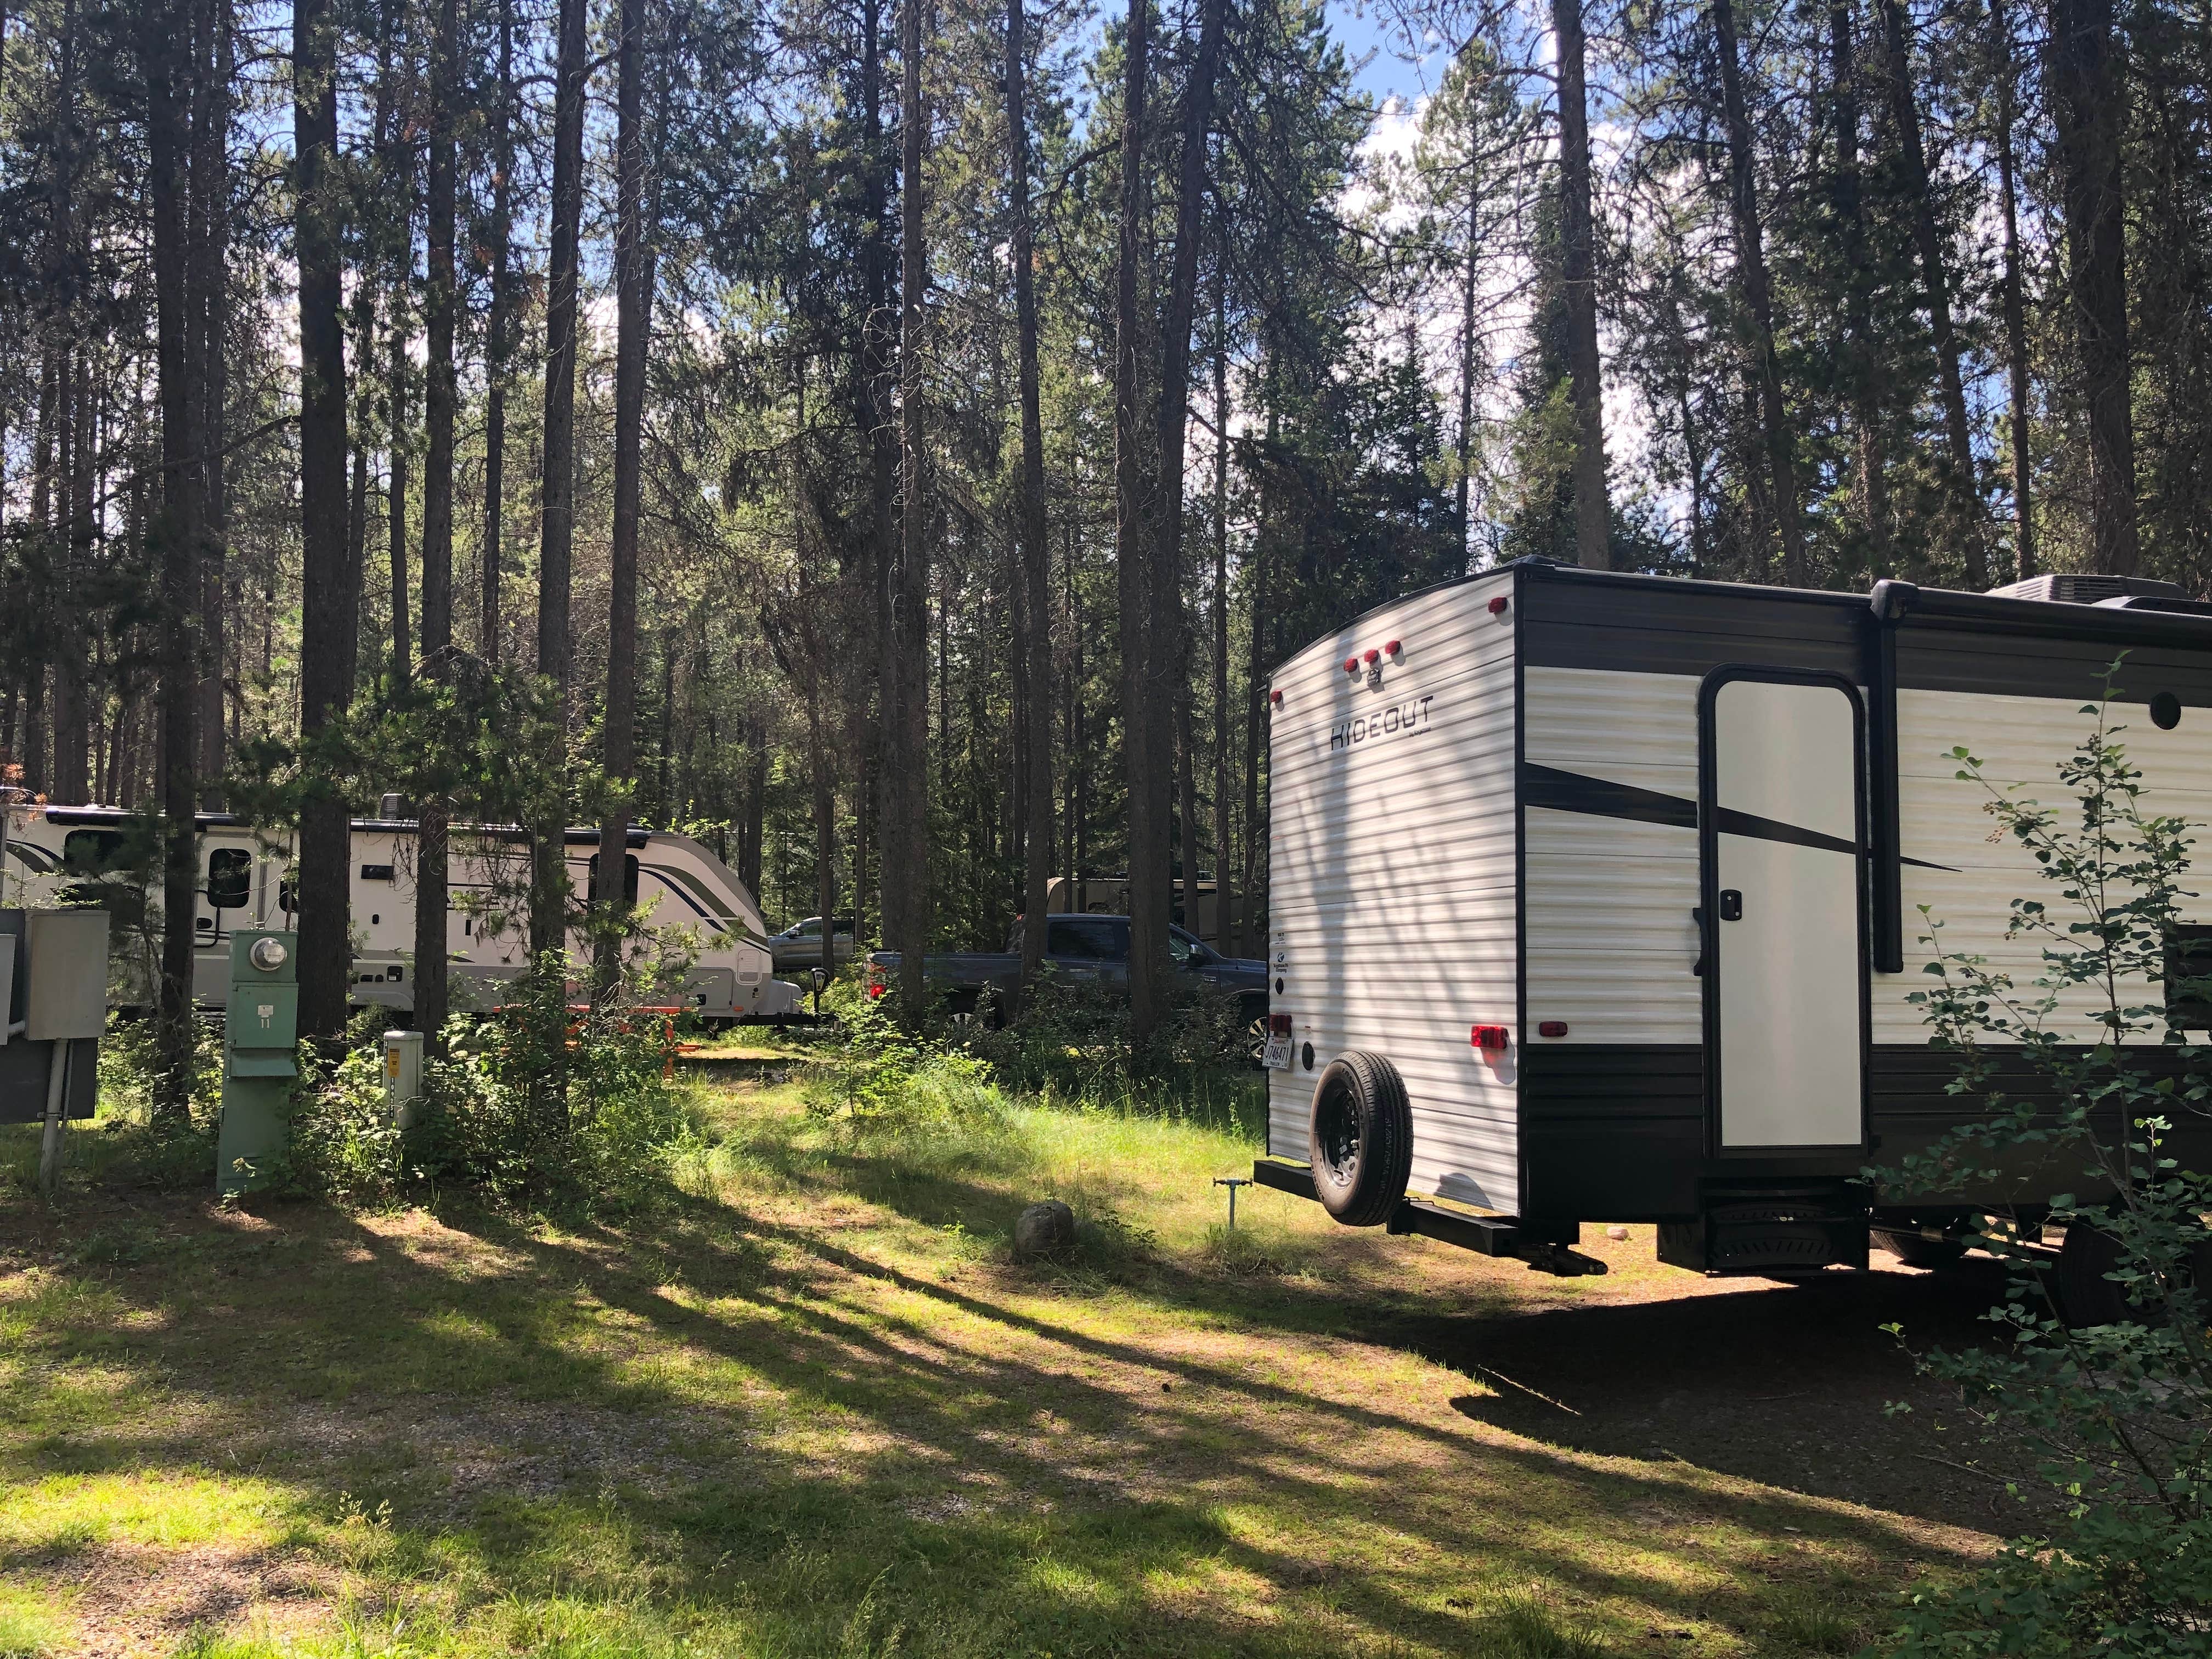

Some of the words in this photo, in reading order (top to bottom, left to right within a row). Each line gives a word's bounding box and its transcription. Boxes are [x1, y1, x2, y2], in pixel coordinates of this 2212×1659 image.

[1330, 695, 1434, 751] HIDEOUT
[261, 1018, 270, 1029] 11
[1265, 1045, 1289, 1062] J746471
